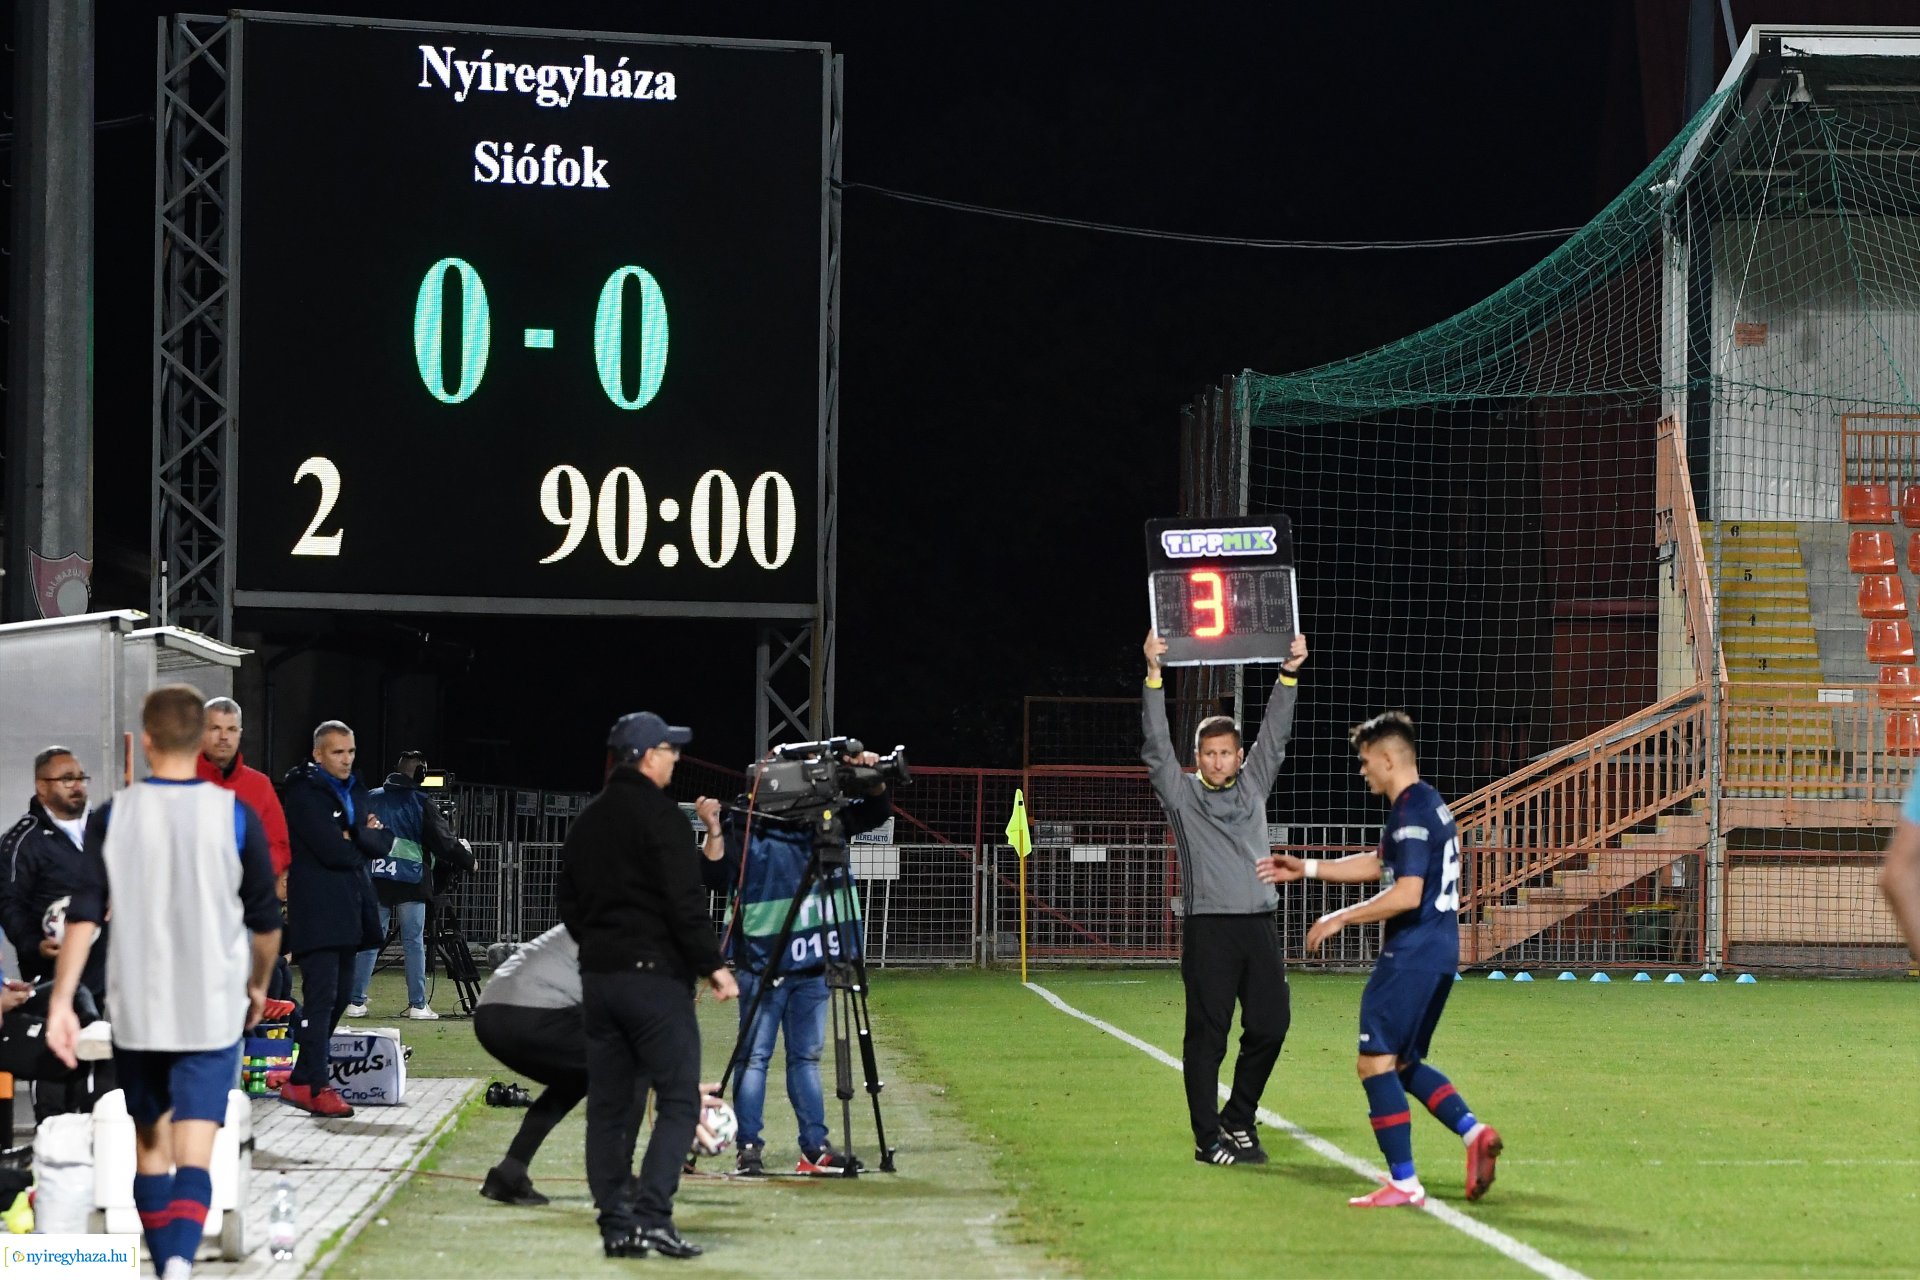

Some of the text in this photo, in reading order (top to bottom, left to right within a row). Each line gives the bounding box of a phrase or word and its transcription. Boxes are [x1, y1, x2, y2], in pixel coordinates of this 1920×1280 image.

[418, 43, 678, 108] Nyíregyháza
[473, 140, 611, 189] Siófok
[413, 256, 491, 404] 0
[593, 264, 670, 411] 0
[290, 456, 344, 556] 2
[538, 464, 797, 570] 90:00
[1190, 571, 1225, 637] 3
[791, 930, 840, 962] 019
[353, 1041, 364, 1052] K
